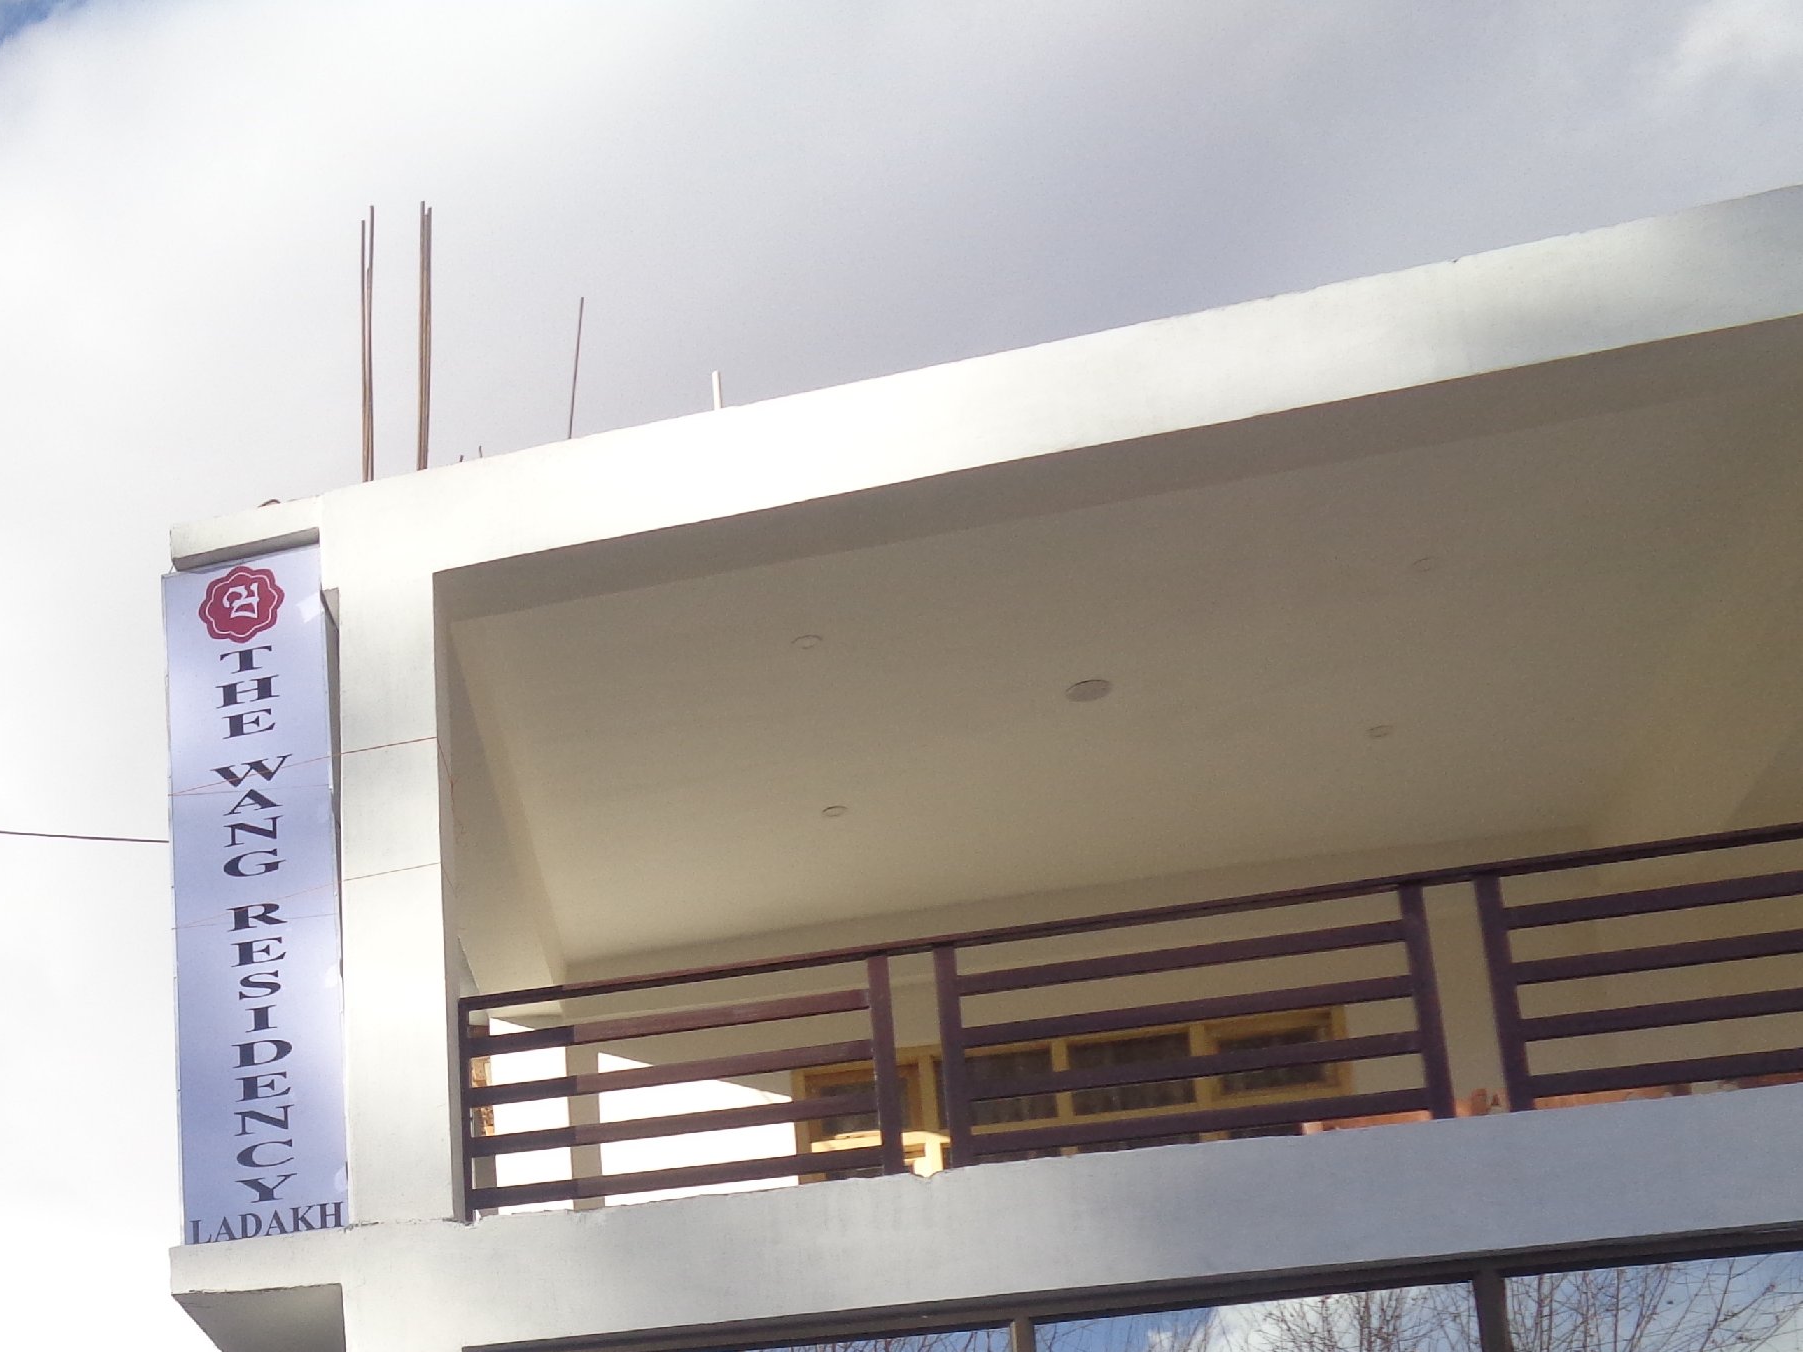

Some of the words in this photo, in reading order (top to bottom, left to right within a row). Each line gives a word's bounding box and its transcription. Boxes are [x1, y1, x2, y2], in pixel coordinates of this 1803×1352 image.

[216, 645, 280, 739] THE
[209, 753, 293, 878] WANG
[226, 902, 297, 1204] RESIDENCY
[190, 1201, 345, 1245] LADAKH
